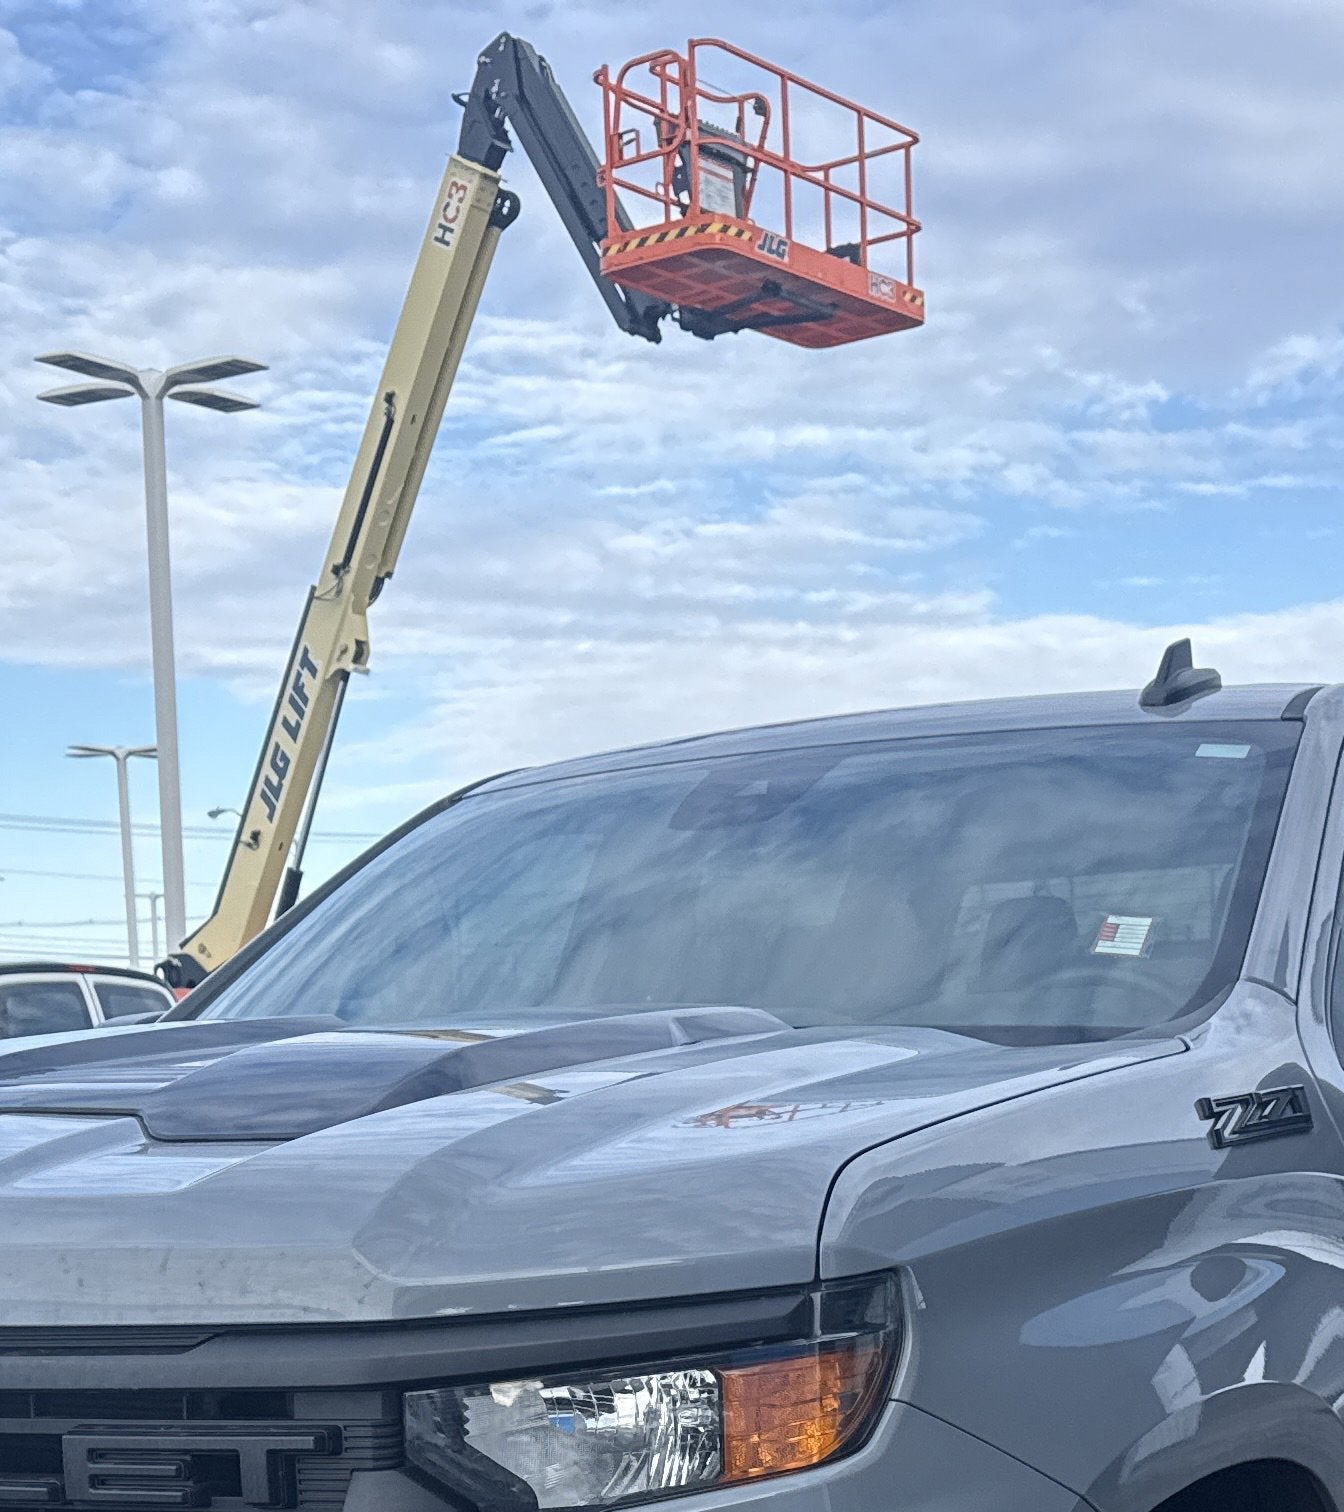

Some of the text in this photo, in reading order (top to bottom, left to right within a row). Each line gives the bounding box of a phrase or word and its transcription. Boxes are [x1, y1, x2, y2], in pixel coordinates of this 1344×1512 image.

[434, 181, 468, 247] HC3
[757, 231, 789, 260] JLG
[260, 644, 318, 824] JLG LIFT
[1194, 1084, 1314, 1150] Z71
